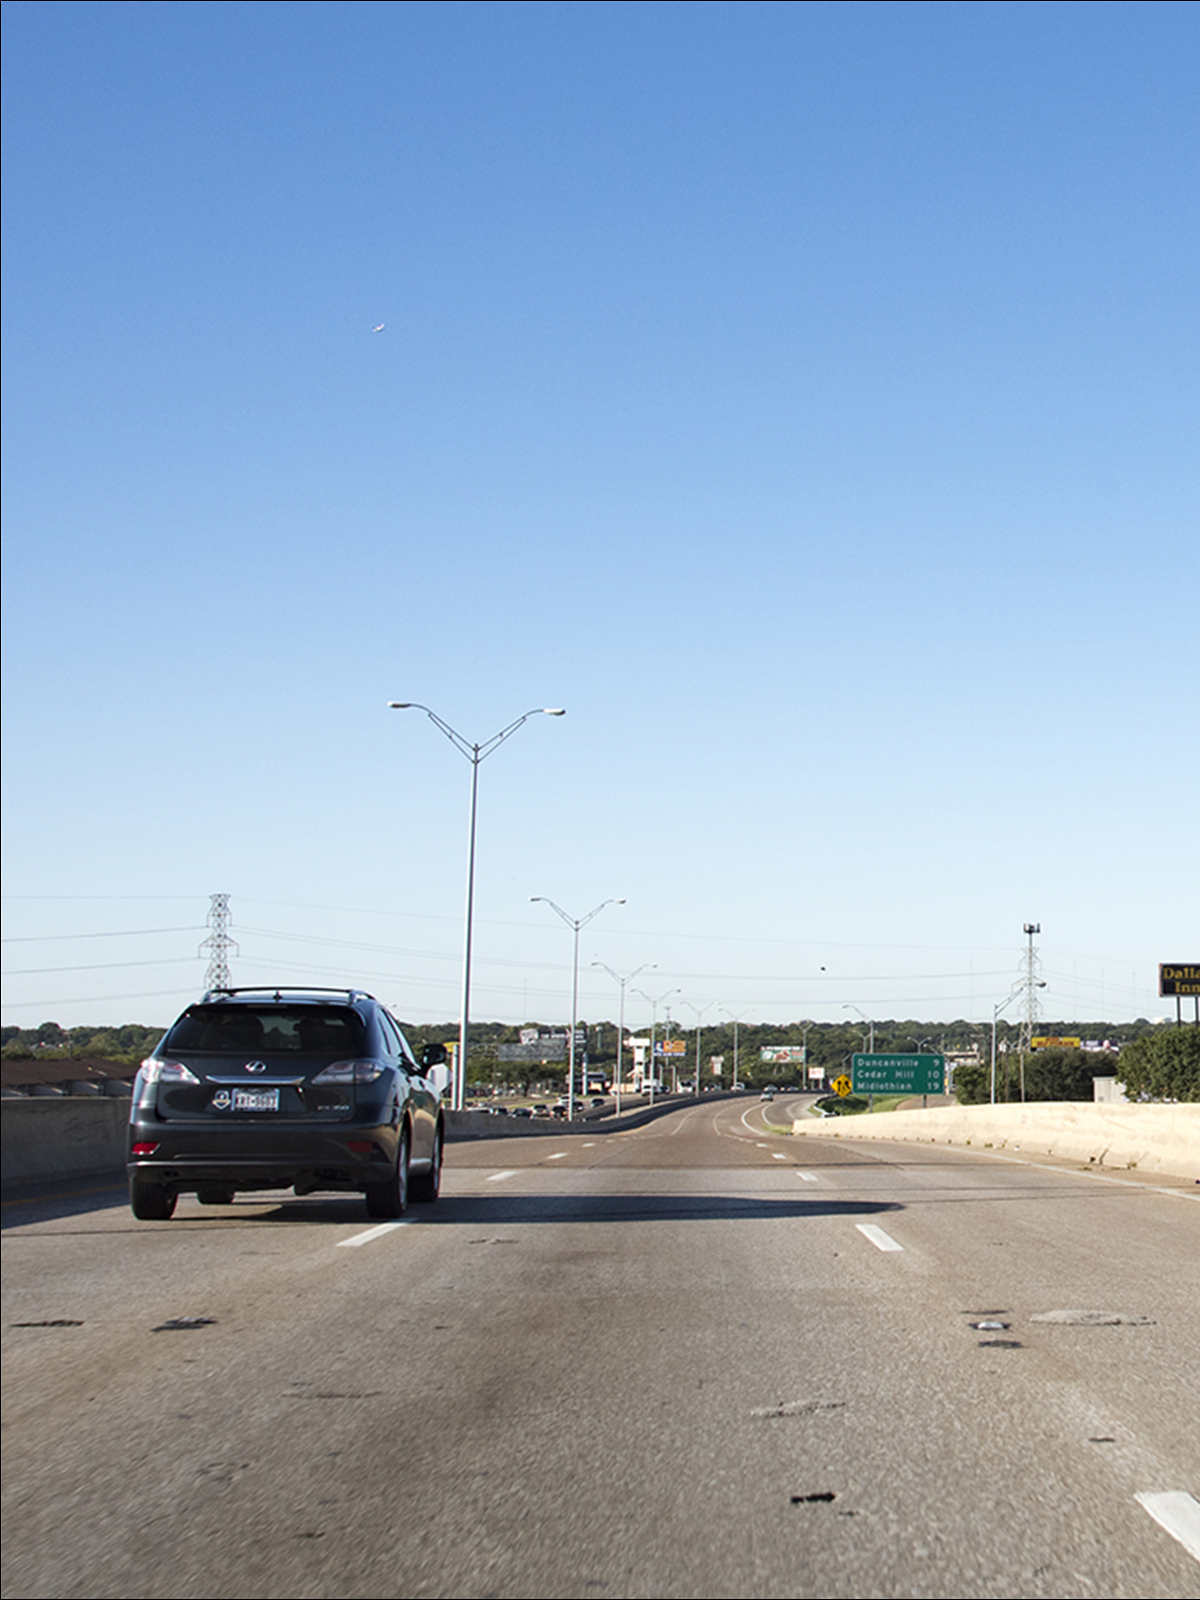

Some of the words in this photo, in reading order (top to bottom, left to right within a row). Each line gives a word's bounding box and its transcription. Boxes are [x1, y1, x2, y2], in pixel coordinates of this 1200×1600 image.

[857, 1058, 919, 1067] Duncanville
[932, 1059, 940, 1067] 9
[857, 1070, 887, 1079] Cedar
[895, 1070, 915, 1079] Hill
[927, 1070, 940, 1079] 10
[857, 1082, 912, 1090] Midlothian
[927, 1082, 940, 1090] 19
